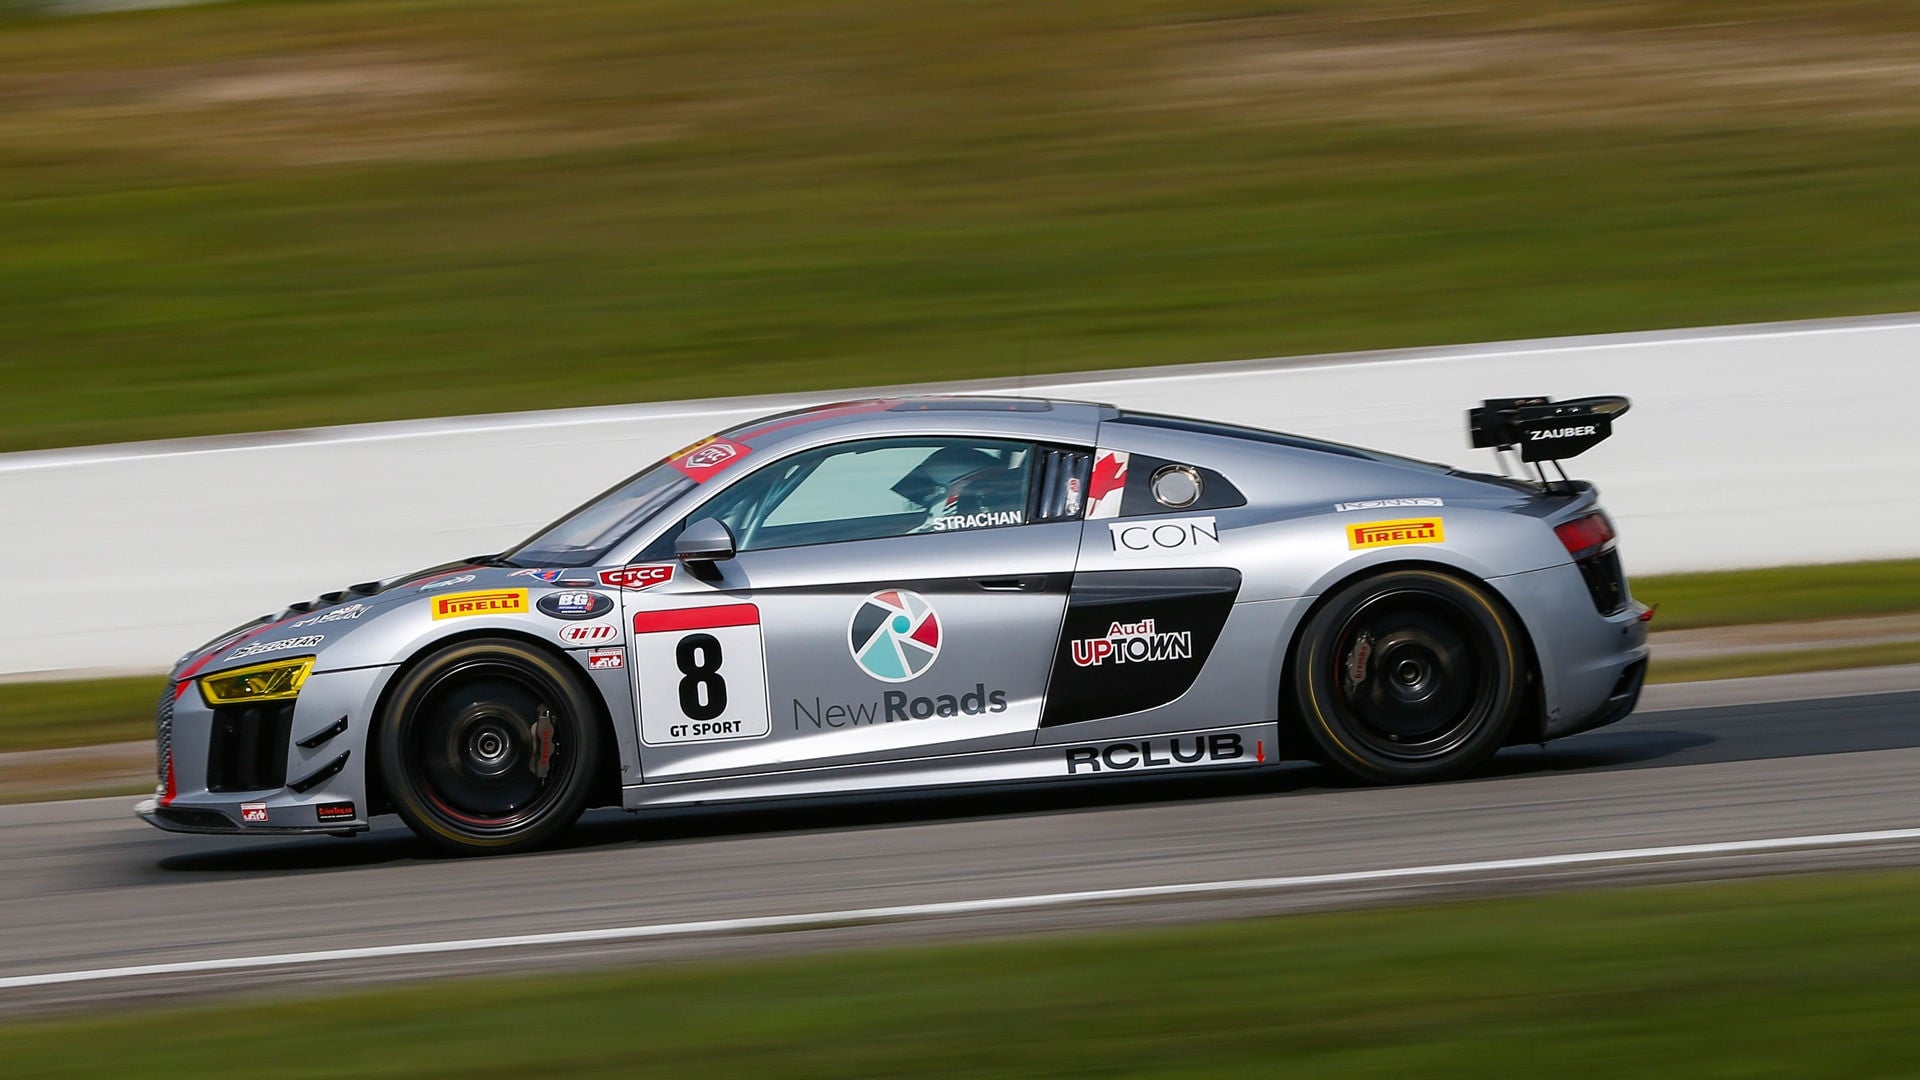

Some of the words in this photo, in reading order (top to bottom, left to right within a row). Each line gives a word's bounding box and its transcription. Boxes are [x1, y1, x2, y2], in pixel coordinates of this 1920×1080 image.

[1530, 425, 1597, 441] ZAUBER
[933, 510, 1023, 532] STRACHAN
[1109, 522, 1220, 552] ICON
[1354, 522, 1436, 545] PIRELLI
[608, 567, 666, 583] CTCC
[438, 593, 520, 615] PIRELLI
[558, 593, 589, 606] BG
[1108, 619, 1156, 637] Audi
[1072, 631, 1192, 667] UPTOWN
[675, 632, 728, 721] 8
[793, 695, 878, 731] New
[883, 683, 1008, 724] Roads
[670, 725, 689, 737] GT
[692, 720, 742, 736] SPORT
[1065, 733, 1244, 775] RCLUB
